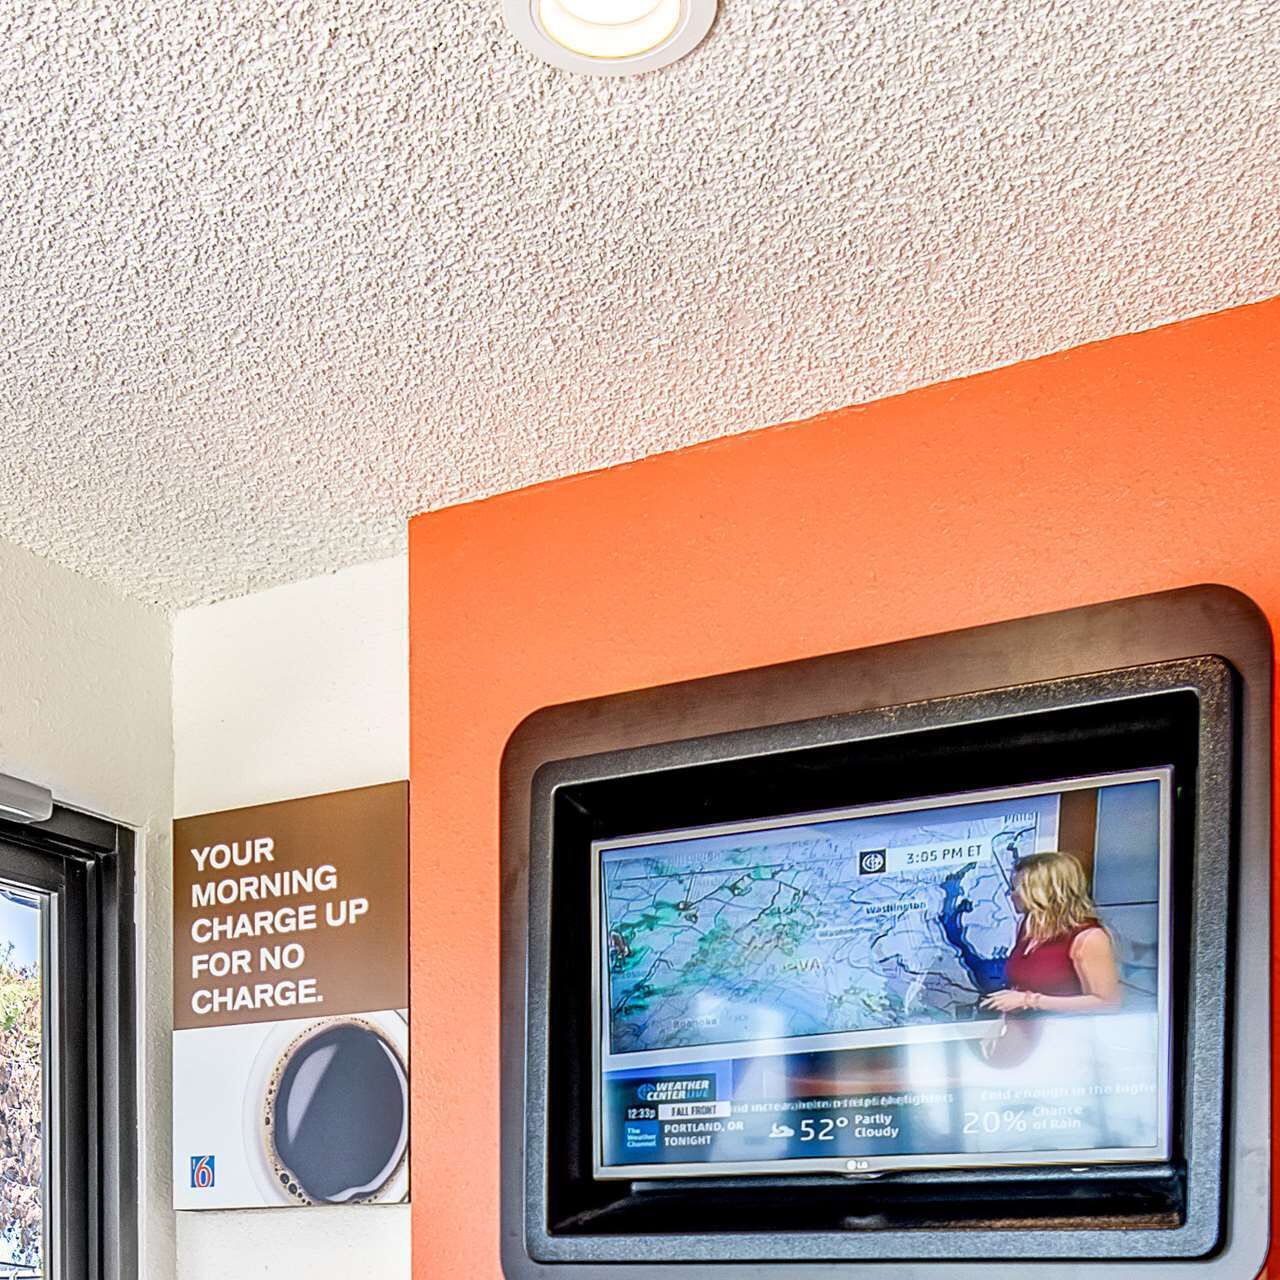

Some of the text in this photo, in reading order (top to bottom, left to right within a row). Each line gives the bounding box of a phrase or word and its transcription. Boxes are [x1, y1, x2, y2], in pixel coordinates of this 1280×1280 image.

[190, 836, 274, 872] YOUR
[906, 844, 982, 864] 3:05 PM ET
[191, 864, 338, 908] MORNING
[866, 900, 927, 914] Washington
[190, 897, 370, 944] CHARGE UP
[191, 943, 305, 979] FOR NO
[190, 978, 324, 1015] CHARGE.
[656, 1080, 709, 1091] WEATHER
[628, 1108, 656, 1119] 12:33p
[671, 1105, 717, 1117] FALL FRONT
[1032, 1105, 1083, 1117] Chance
[854, 1113, 892, 1126] Partly
[963, 1110, 1027, 1135] 20%
[1050, 1119, 1081, 1129] Rain
[664, 1121, 744, 1133] PORTLAND, OR
[800, 1116, 849, 1141] 52°
[854, 1126, 899, 1138] Cloudy
[664, 1135, 712, 1146] TONIGHT
